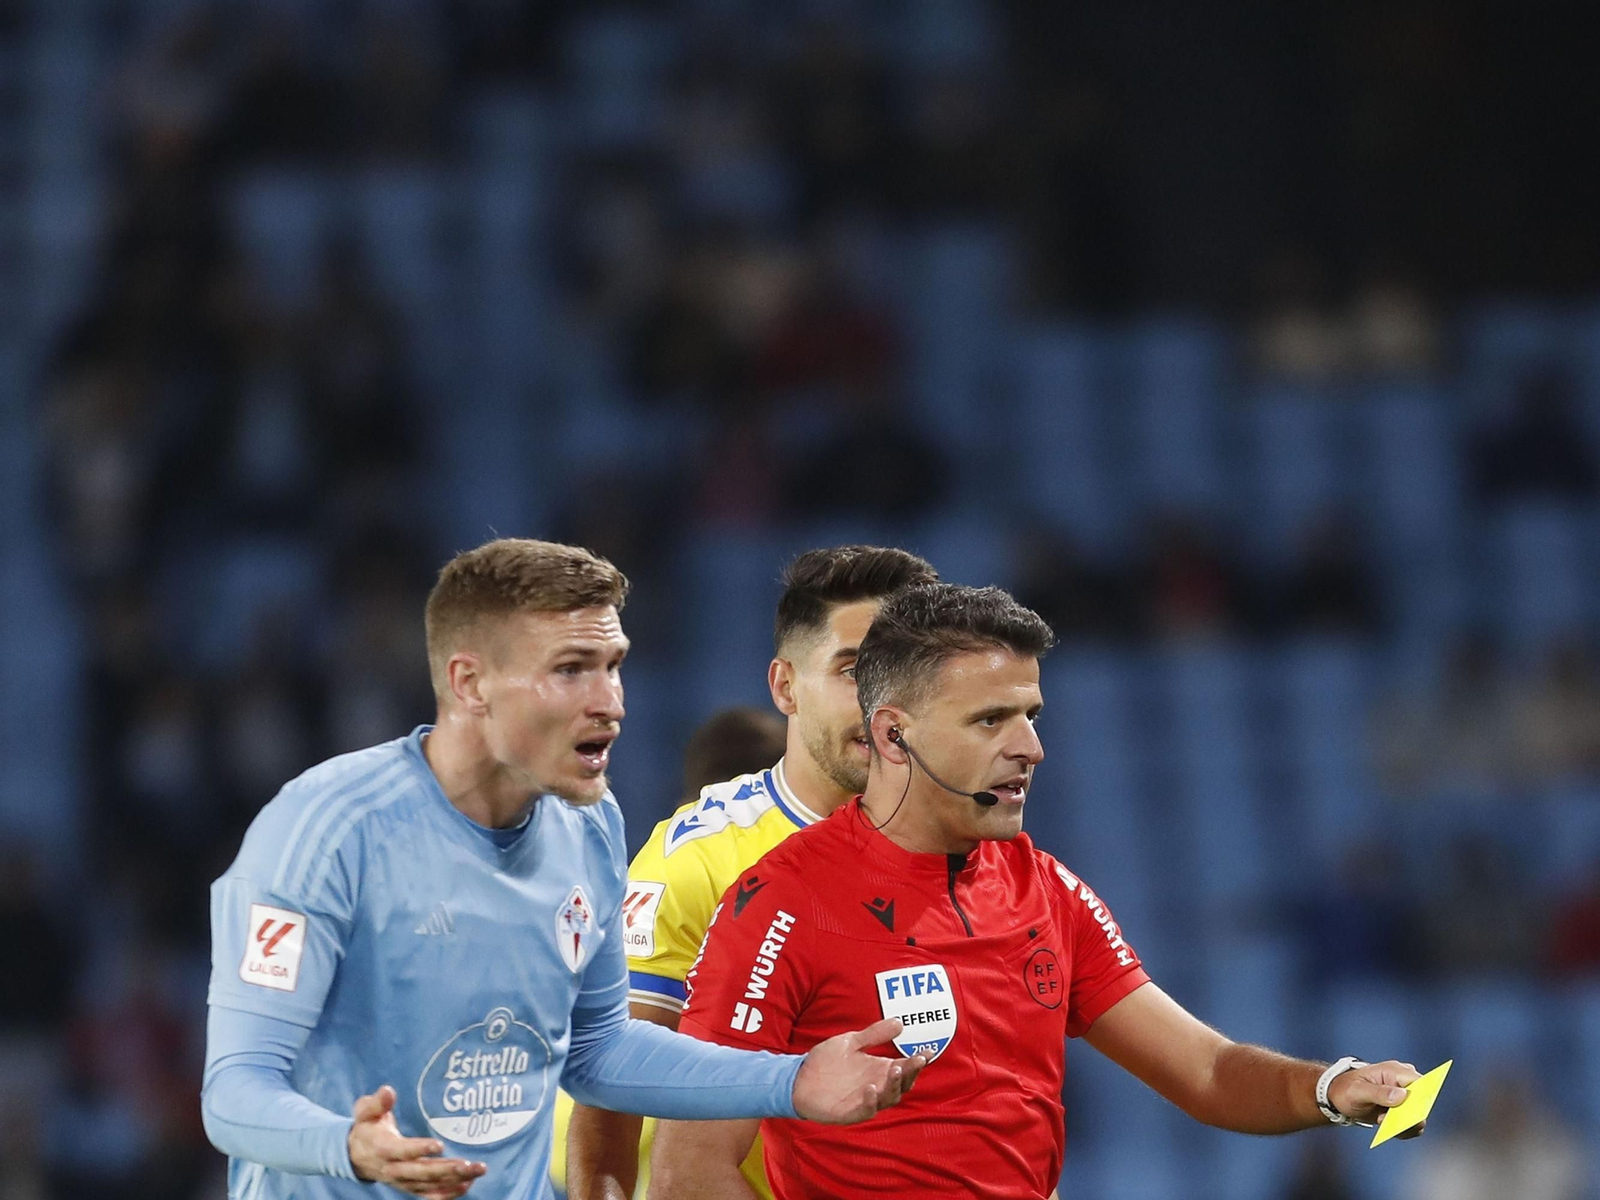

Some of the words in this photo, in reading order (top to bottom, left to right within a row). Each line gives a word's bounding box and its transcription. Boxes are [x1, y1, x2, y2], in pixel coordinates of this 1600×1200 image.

[744, 909, 797, 1000] WÜRTH
[1034, 963, 1055, 978] RF
[884, 971, 945, 1000] FIFA
[1037, 980, 1058, 995] EF
[893, 1008, 951, 1027] EFEREE
[443, 1046, 529, 1080] Estrella
[443, 1076, 522, 1113] Galicia
